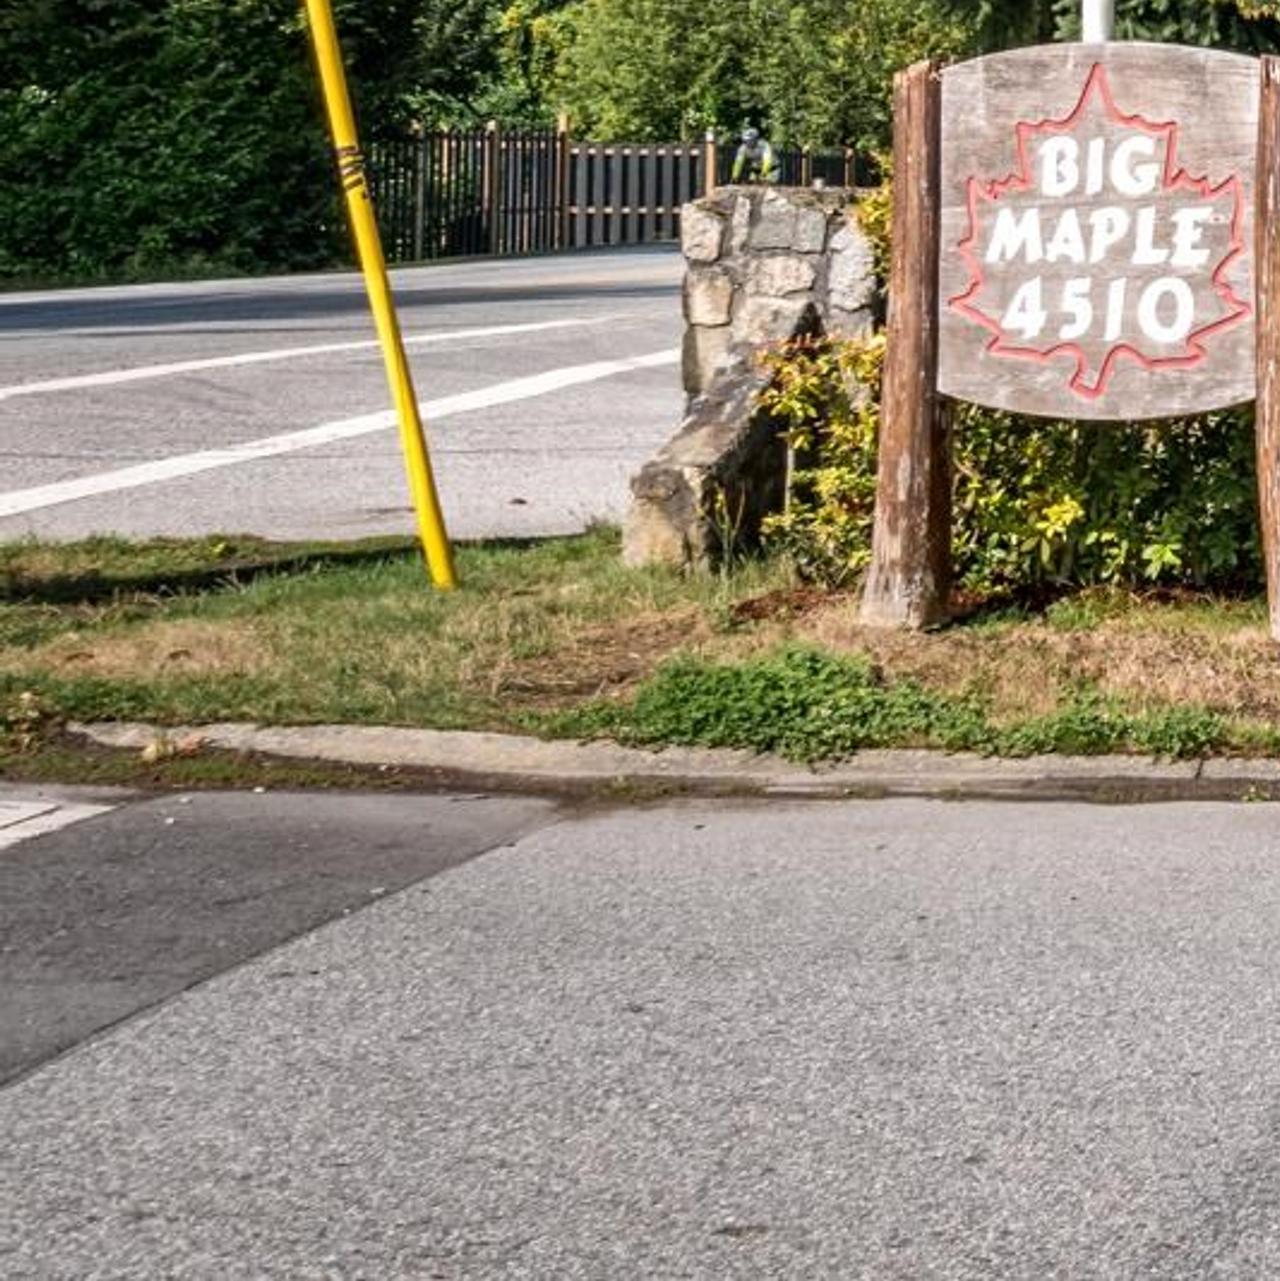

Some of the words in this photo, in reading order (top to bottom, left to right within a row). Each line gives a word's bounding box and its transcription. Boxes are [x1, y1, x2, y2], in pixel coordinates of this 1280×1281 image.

[1037, 135, 1162, 197] BIG
[985, 206, 1214, 268] MAPLE
[1001, 276, 1195, 343] 4510
